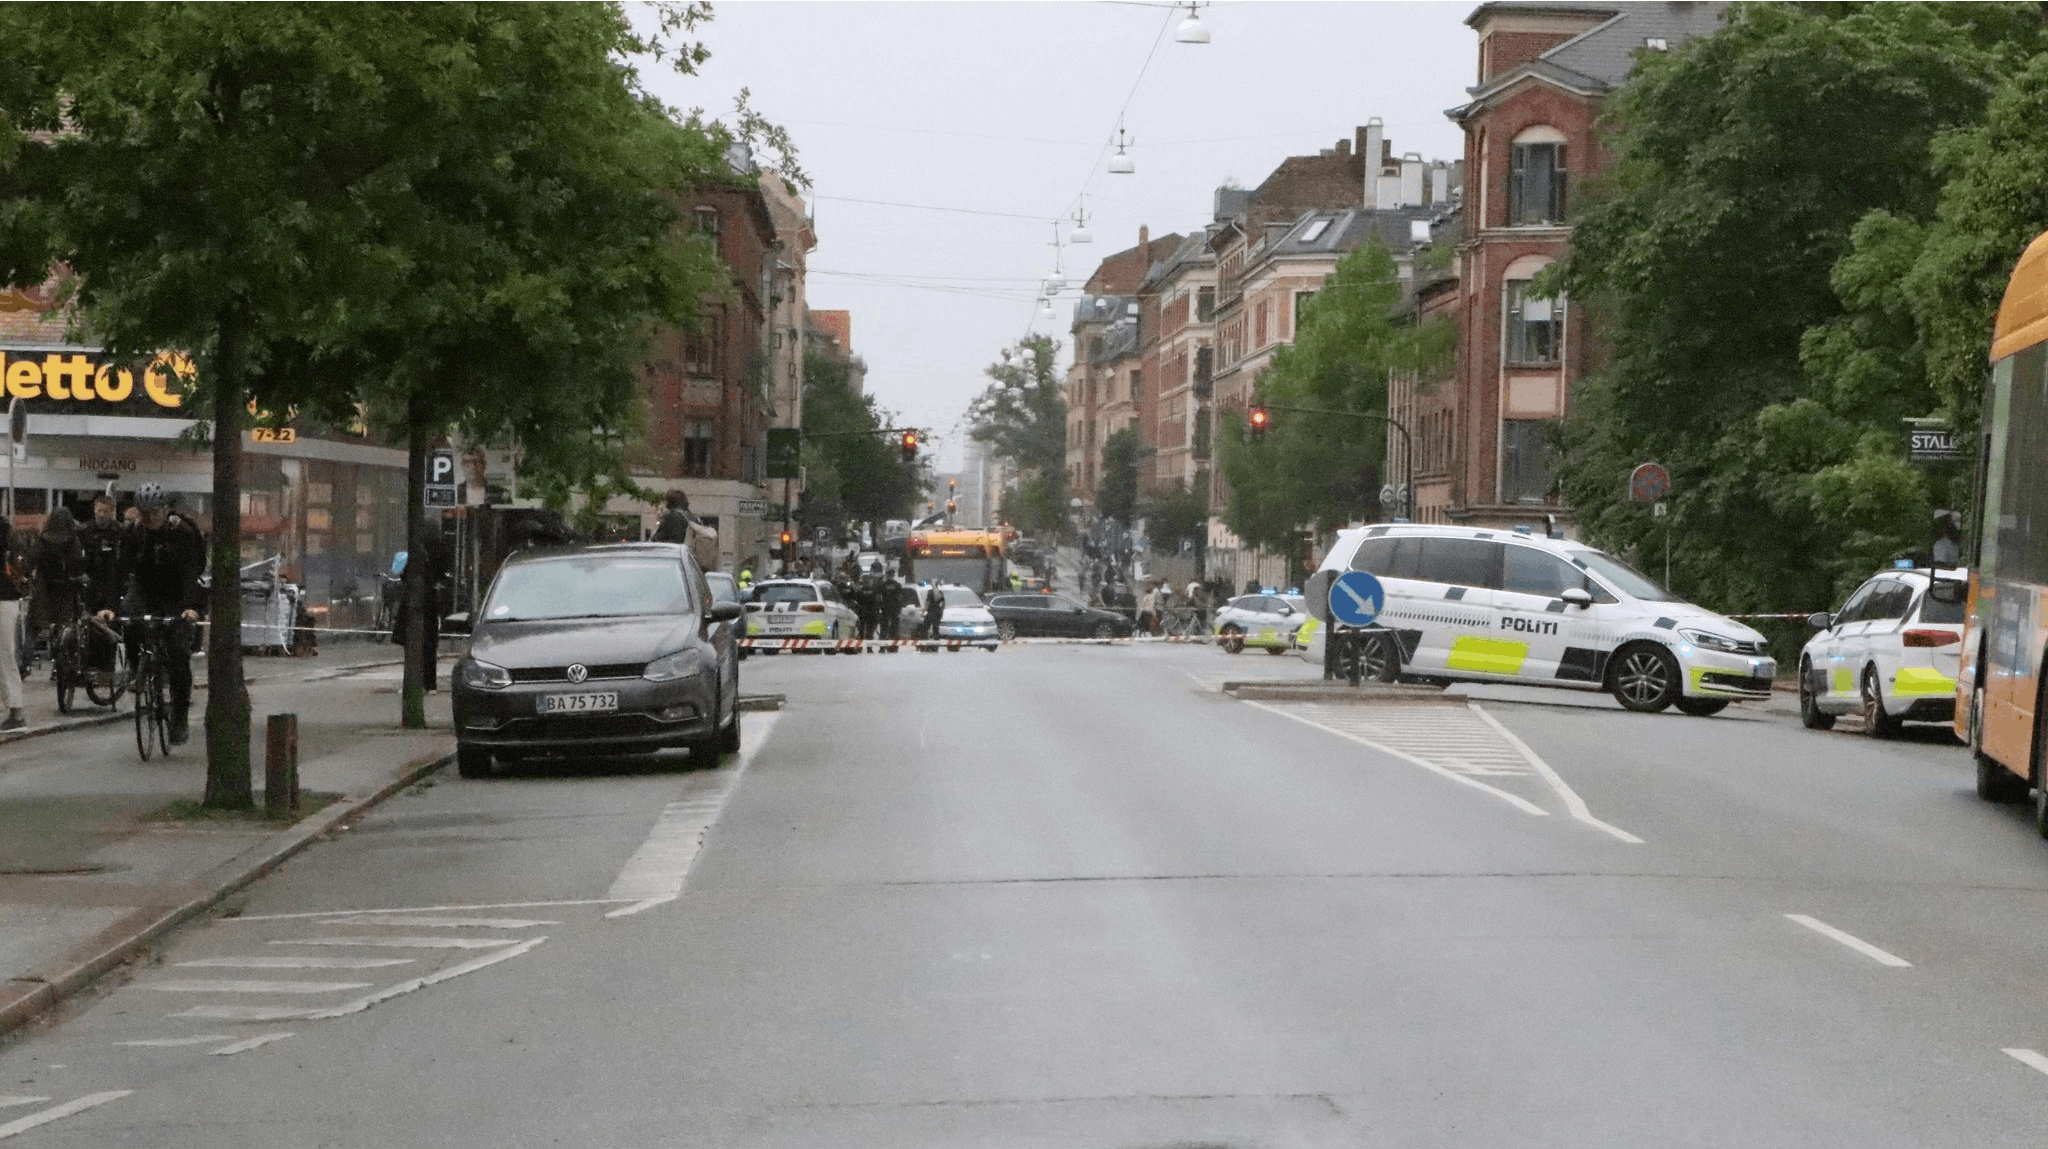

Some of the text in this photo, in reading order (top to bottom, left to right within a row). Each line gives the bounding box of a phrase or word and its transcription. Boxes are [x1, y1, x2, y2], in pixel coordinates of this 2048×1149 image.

[0, 352, 133, 402] etto
[433, 456, 451, 482] P
[1501, 616, 1558, 636] POLITI
[547, 694, 615, 710] BA 75 732
